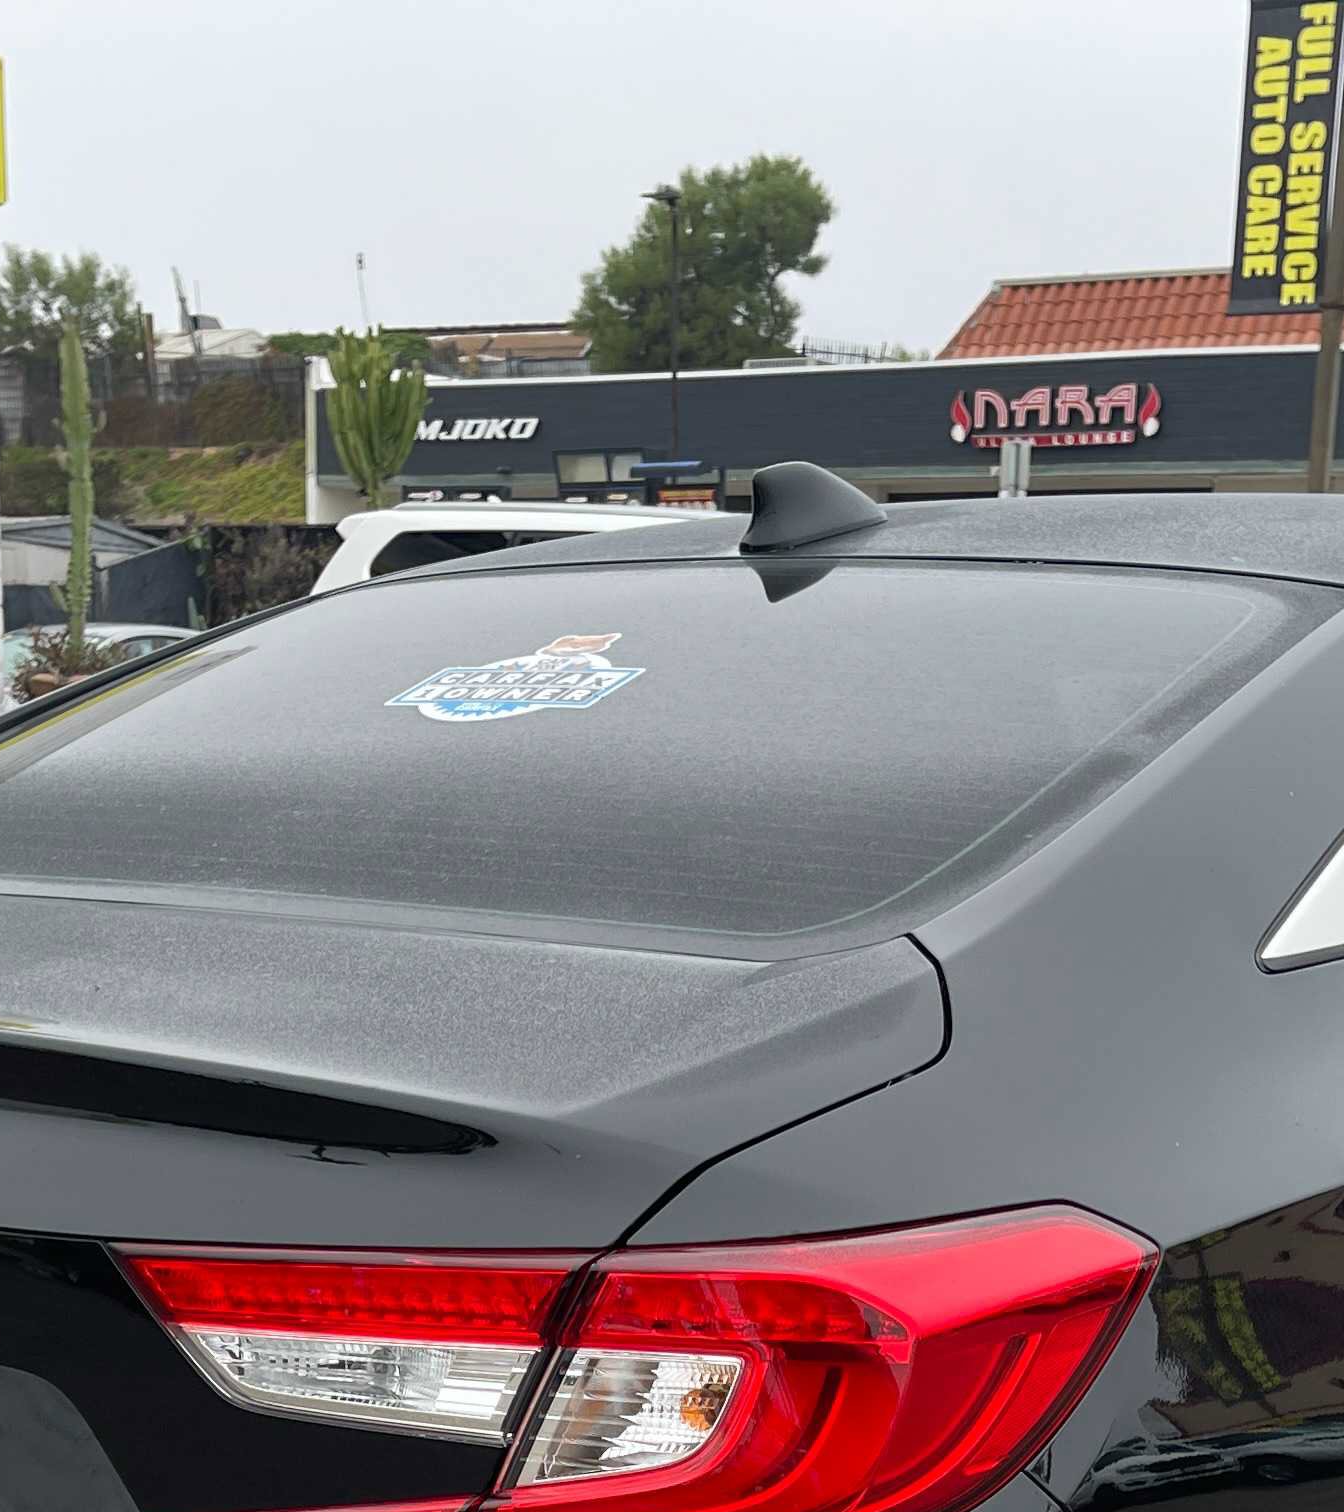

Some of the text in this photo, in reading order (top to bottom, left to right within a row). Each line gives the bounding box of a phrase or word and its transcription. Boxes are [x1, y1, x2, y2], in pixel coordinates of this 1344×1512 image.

[1242, 36, 1292, 279] AUTO CARE
[1280, 2, 1337, 305] FULL SERVICE
[974, 383, 1138, 428] NARA
[1052, 431, 1134, 446] LOUNGE
[439, 671, 609, 687] CARFAX
